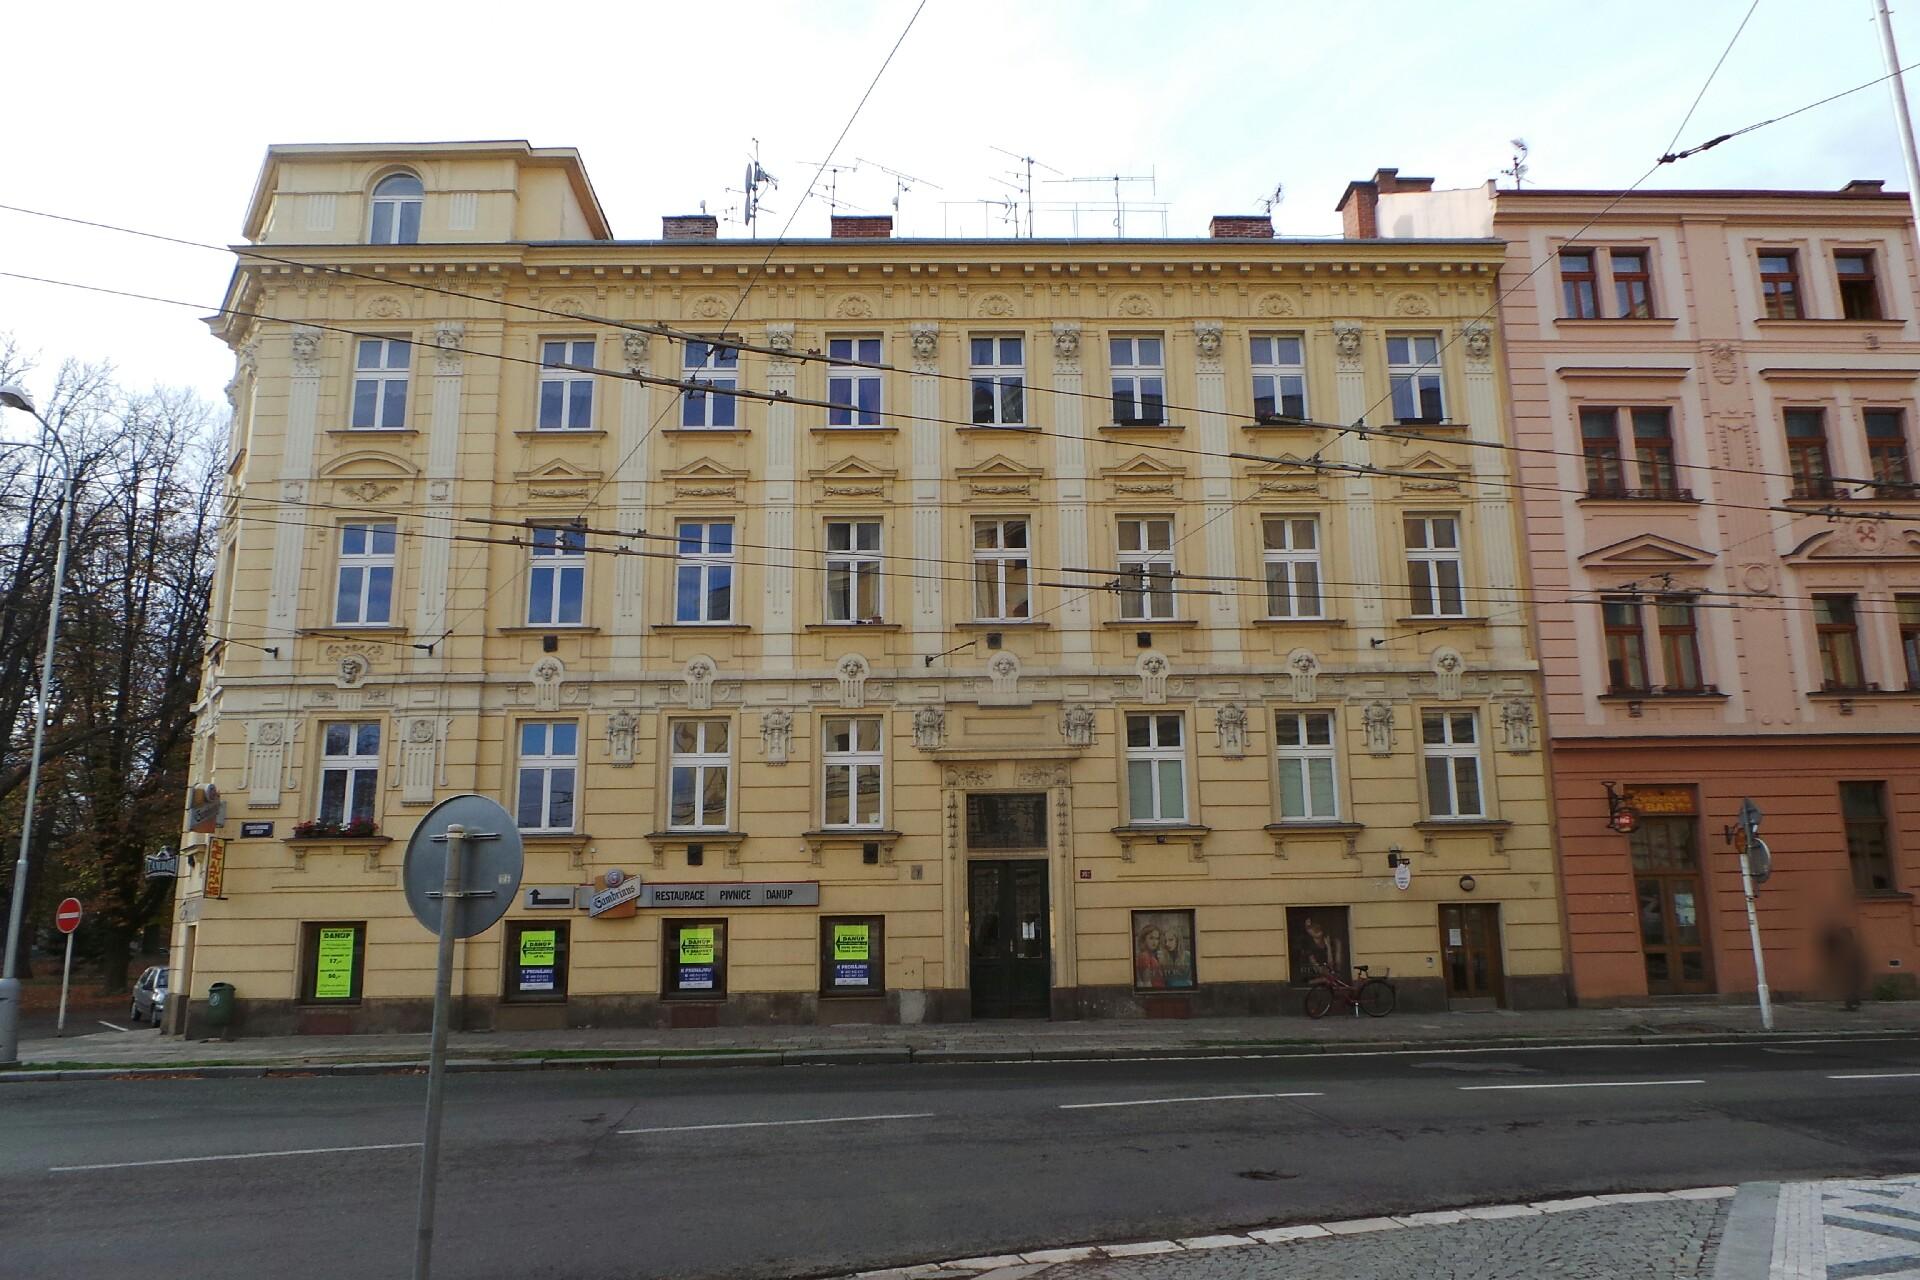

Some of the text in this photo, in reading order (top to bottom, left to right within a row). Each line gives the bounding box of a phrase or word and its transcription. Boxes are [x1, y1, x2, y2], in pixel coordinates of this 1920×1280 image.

[1647, 803, 1675, 812] BAR
[655, 889, 793, 901] RESTAURACE PIVNICE DANUP
